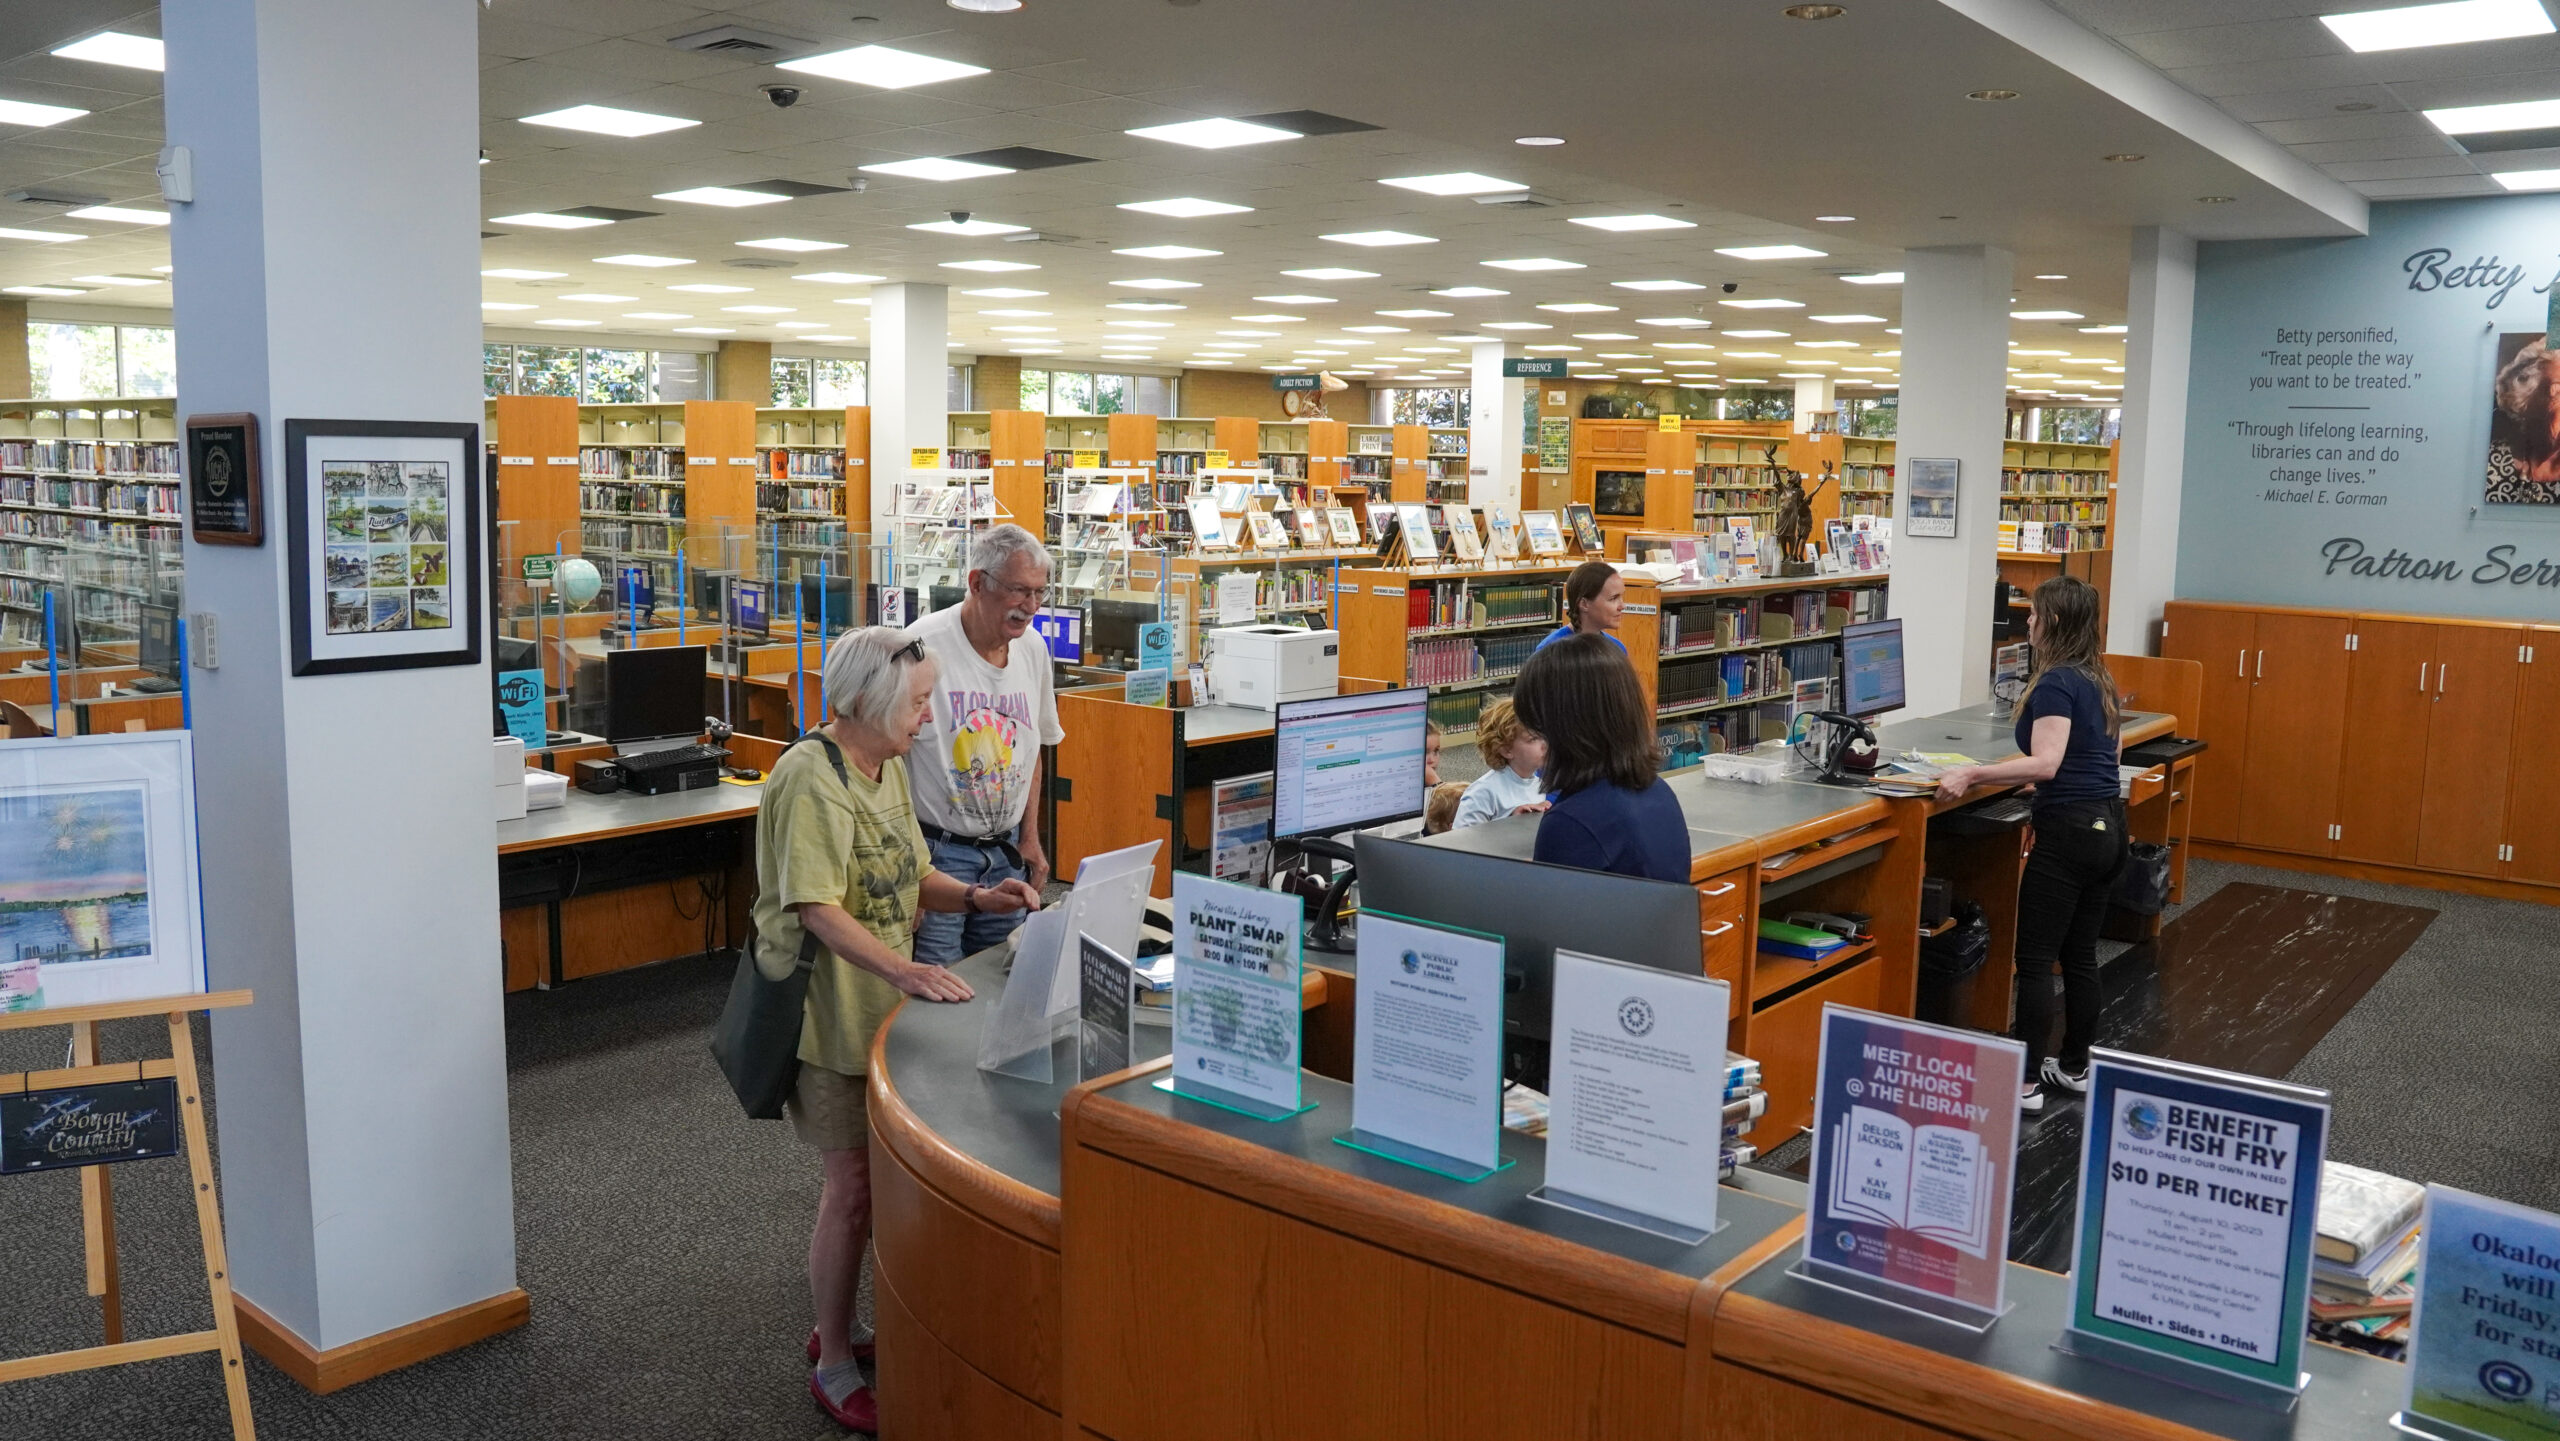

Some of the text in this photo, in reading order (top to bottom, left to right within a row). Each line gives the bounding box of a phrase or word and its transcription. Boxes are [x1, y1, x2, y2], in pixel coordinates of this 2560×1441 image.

[2403, 247, 2526, 309] Betty
[2277, 327, 2397, 346] Betty personified,
[1517, 363, 1551, 372] REFERENCE
[2261, 351, 2413, 368] “Treat people the way
[1295, 378, 1313, 386] FICTION
[2249, 376, 2272, 391] you
[2278, 375, 2309, 388] want
[2315, 375, 2328, 388] to
[2333, 374, 2349, 388] be
[2228, 421, 2428, 442] “Through lifelong learning,
[2252, 444, 2399, 461] libraries can and do
[2270, 468, 2321, 485] change
[2264, 489, 2314, 502] Michael
[2318, 491, 2329, 503] E.
[2336, 492, 2387, 505] Gorman
[2321, 537, 2464, 582] Patron
[1203, 899, 1270, 927] Niceville Library
[1190, 911, 1284, 944] PLANT SWAP
[1204, 949, 1220, 961] 10:00
[1224, 954, 1234, 964] AM
[1258, 962, 1268, 973] PM
[1238, 943, 1263, 956] AUGUST
[1421, 952, 1458, 966] NICEVILLE
[1423, 970, 1455, 982] LIBRARY
[1426, 962, 1453, 973] PUBLIC
[1863, 1043, 1977, 1082] MEET LOCAL
[1874, 1065, 1962, 1098] AUTHORS
[1846, 1078, 1990, 1123] @ THE LIBRARY
[58, 1110, 128, 1134] Boggy
[1862, 1123, 1900, 1140] DELOIS
[2168, 1105, 2278, 1145] BENEFIT
[48, 1129, 136, 1152] Country
[1858, 1132, 1903, 1151] JACKSON
[1932, 1132, 1962, 1145] Saturday
[2166, 1128, 2288, 1170] FISH FRY
[1875, 1158, 1882, 1167] &
[1921, 1161, 1967, 1177] Public Library
[2117, 1142, 2287, 1185] TO HELP ONE OF OUR OWN IN NEED
[1861, 1186, 1892, 1200] KIZER
[1866, 1177, 1887, 1189] KAY
[2111, 1160, 2289, 1217] $10 PER TICKET
[2129, 1198, 2174, 1216] Thursday,
[2179, 1210, 2213, 1225] August
[2232, 1222, 2263, 1237] 2023
[2147, 1228, 2239, 1257] Mullet Festival Site
[2173, 1223, 2189, 1232] am
[2199, 1228, 2207, 1236] 2
[2208, 1231, 2225, 1240] pm
[2106, 1231, 2125, 1242] Pick
[2128, 1237, 2140, 1246] up
[2154, 1244, 2181, 1255] picnic
[2184, 1251, 2211, 1263] under
[2215, 1258, 2231, 1268] the
[2233, 1263, 2251, 1273] oak
[2118, 1259, 2134, 1270] Get
[2137, 1264, 2168, 1279] tickets
[2170, 1272, 2180, 1281] at
[2183, 1275, 2221, 1292] Niceville
[2502, 1272, 2555, 1300] will
[2120, 1272, 2149, 1286] Public
[2188, 1290, 2219, 1304] Senior
[2222, 1299, 2256, 1312] Center
[2151, 1293, 2221, 1319] & Utility Billing
[2461, 1286, 2557, 1332] Friday,
[2112, 1305, 2258, 1353] Mullet Sides Drink
[2475, 1318, 2515, 1346] for
